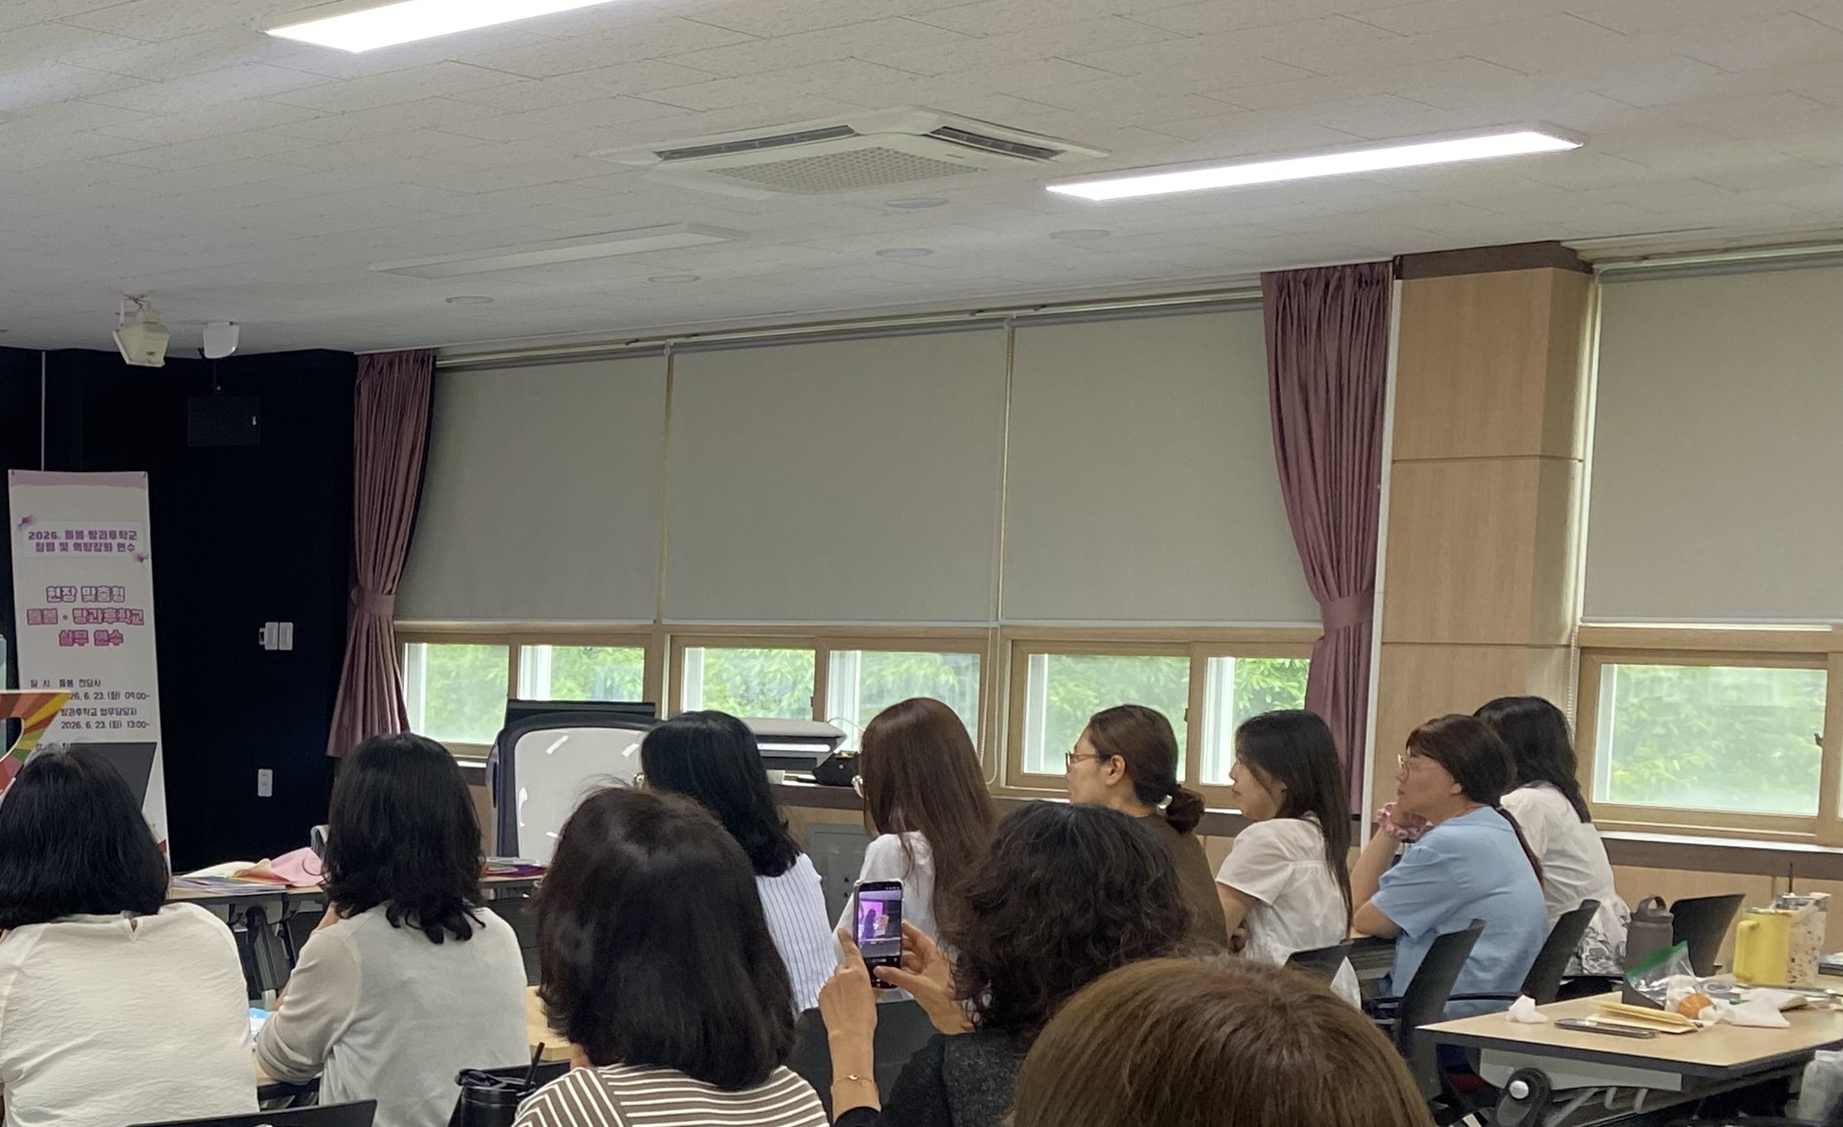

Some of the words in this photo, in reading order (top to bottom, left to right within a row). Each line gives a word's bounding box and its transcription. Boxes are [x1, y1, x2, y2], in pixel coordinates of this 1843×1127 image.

[117, 542, 136, 553] 연수
[46, 585, 77, 603] 현장
[81, 585, 125, 603] 맞춤형
[27, 608, 58, 625] 돌봄
[72, 607, 144, 625] 방과후학교
[58, 629, 89, 647] 실무
[93, 629, 124, 647] 연수
